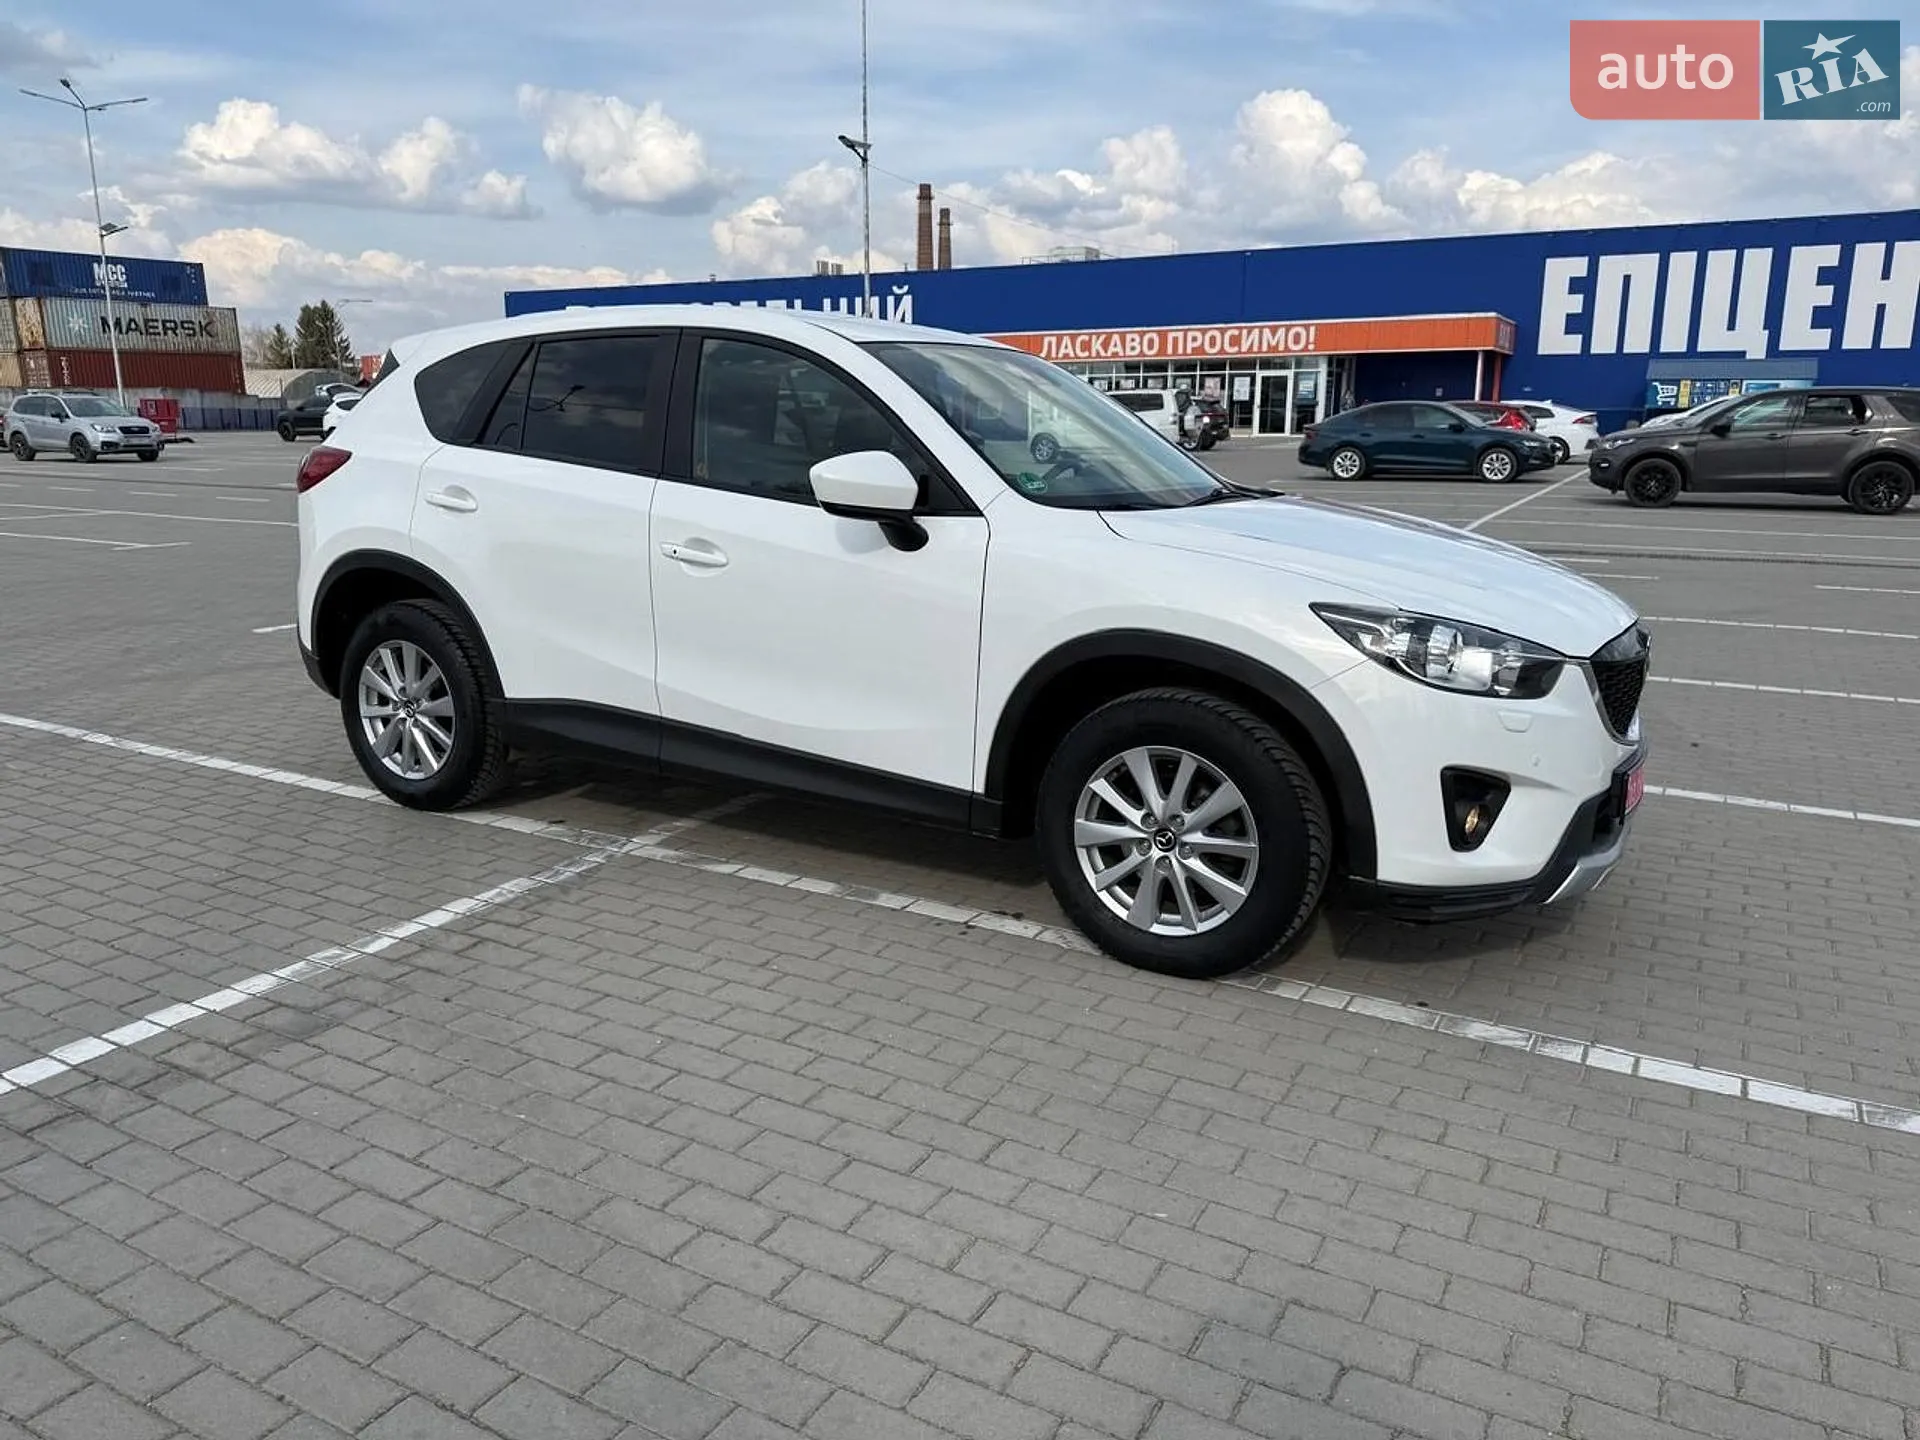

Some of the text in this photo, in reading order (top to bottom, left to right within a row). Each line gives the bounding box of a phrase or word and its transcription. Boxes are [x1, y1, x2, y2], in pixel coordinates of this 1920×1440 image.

[1537, 240, 1920, 359] ЕПІЦЕН
[100, 316, 218, 338] MAERSK
[1040, 326, 1317, 359] ЛАСКАВО ПРОСИМО!
